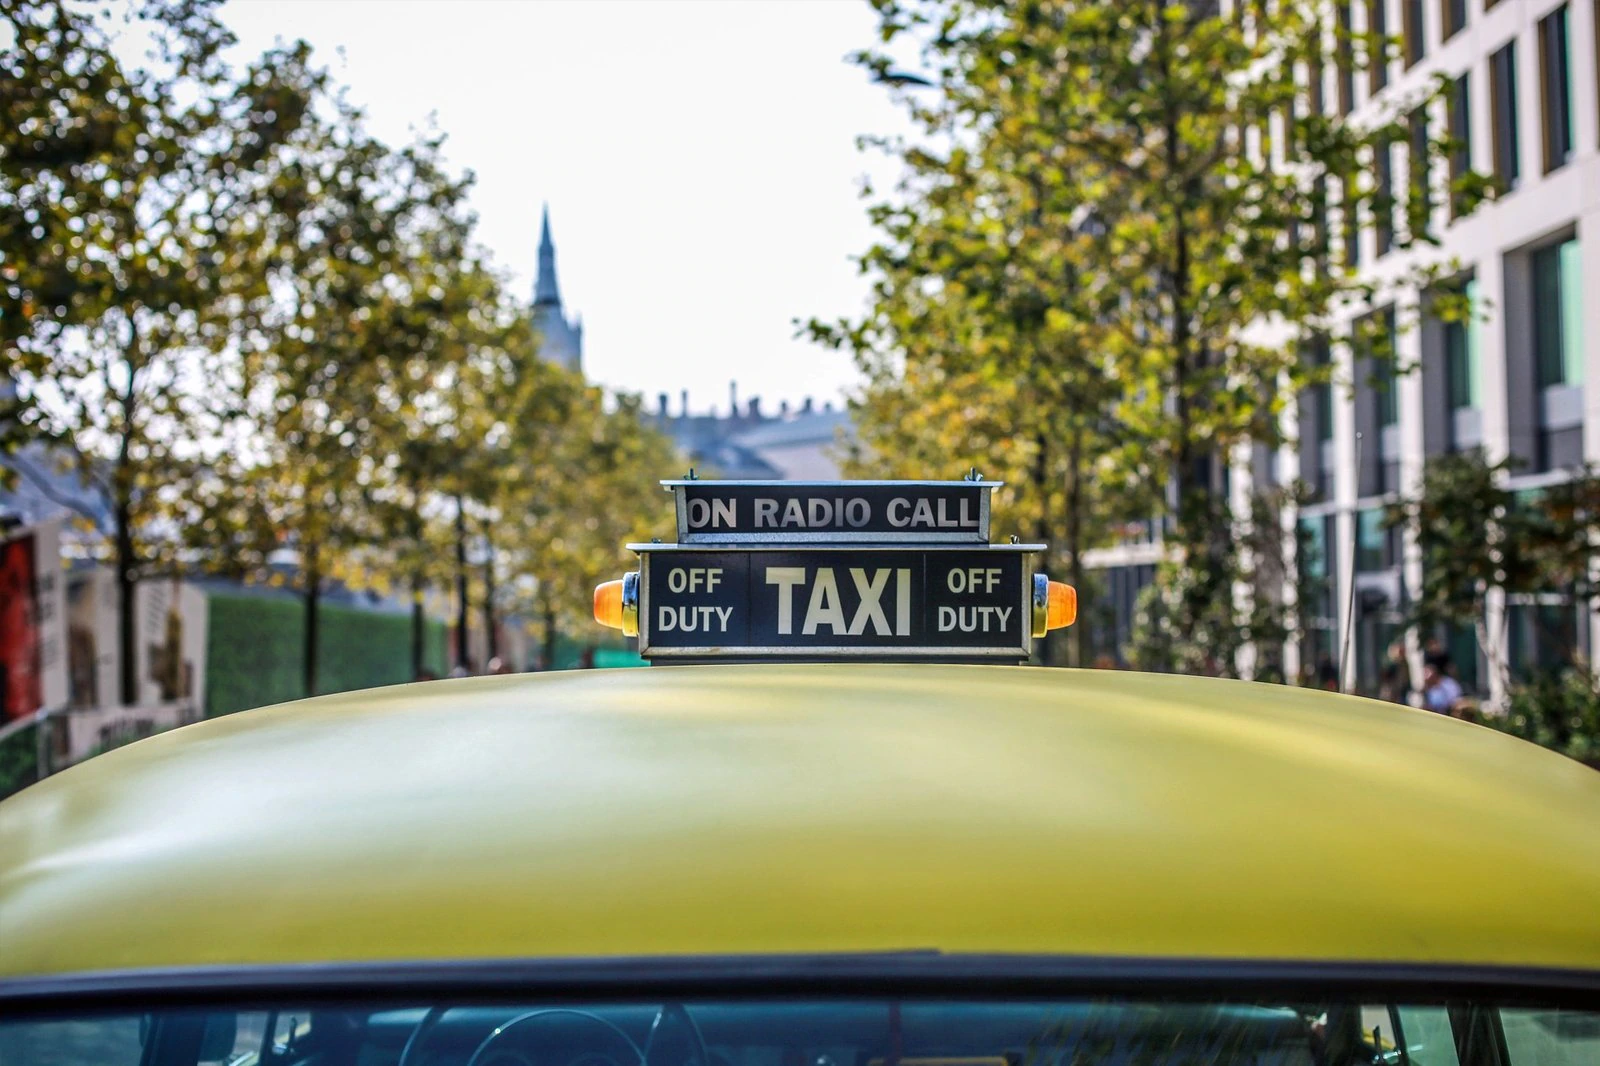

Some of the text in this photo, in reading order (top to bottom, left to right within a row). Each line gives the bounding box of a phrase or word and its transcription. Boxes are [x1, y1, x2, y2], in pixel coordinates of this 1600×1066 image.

[688, 497, 980, 528] ON RADIO CALL
[667, 567, 723, 594] OFF
[946, 567, 1002, 594] OFF
[765, 567, 911, 636] TAXI
[658, 605, 733, 632] DUTY
[937, 605, 1013, 632] DUTY
